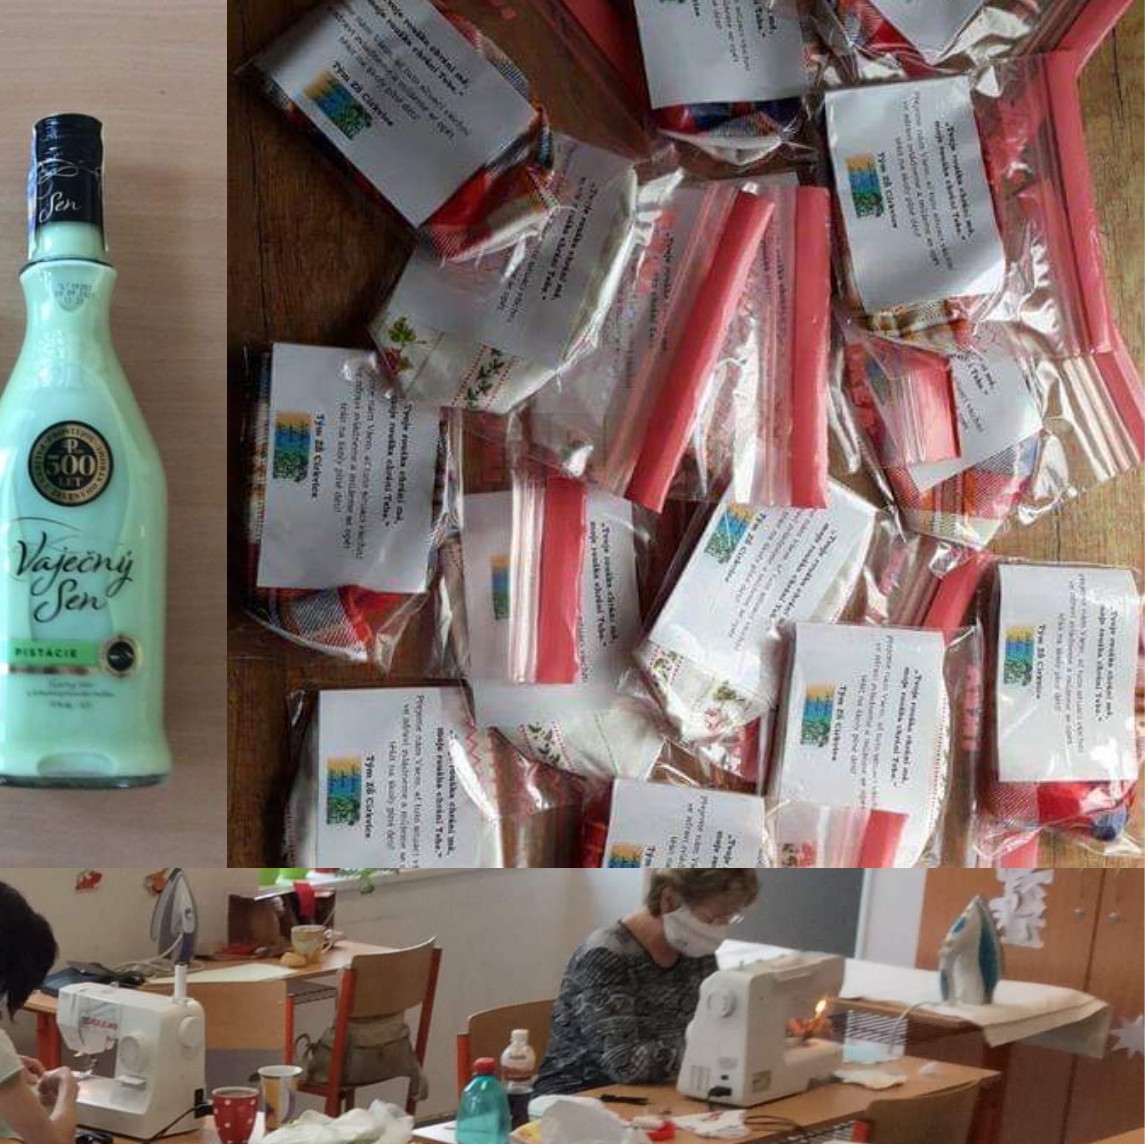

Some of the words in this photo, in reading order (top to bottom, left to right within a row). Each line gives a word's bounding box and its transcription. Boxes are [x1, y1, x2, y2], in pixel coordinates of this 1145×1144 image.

[46, 454, 95, 476] 500
[17, 531, 134, 597] Vaječný
[33, 579, 107, 623] Sen
[15, 648, 78, 658] PISTACIE
